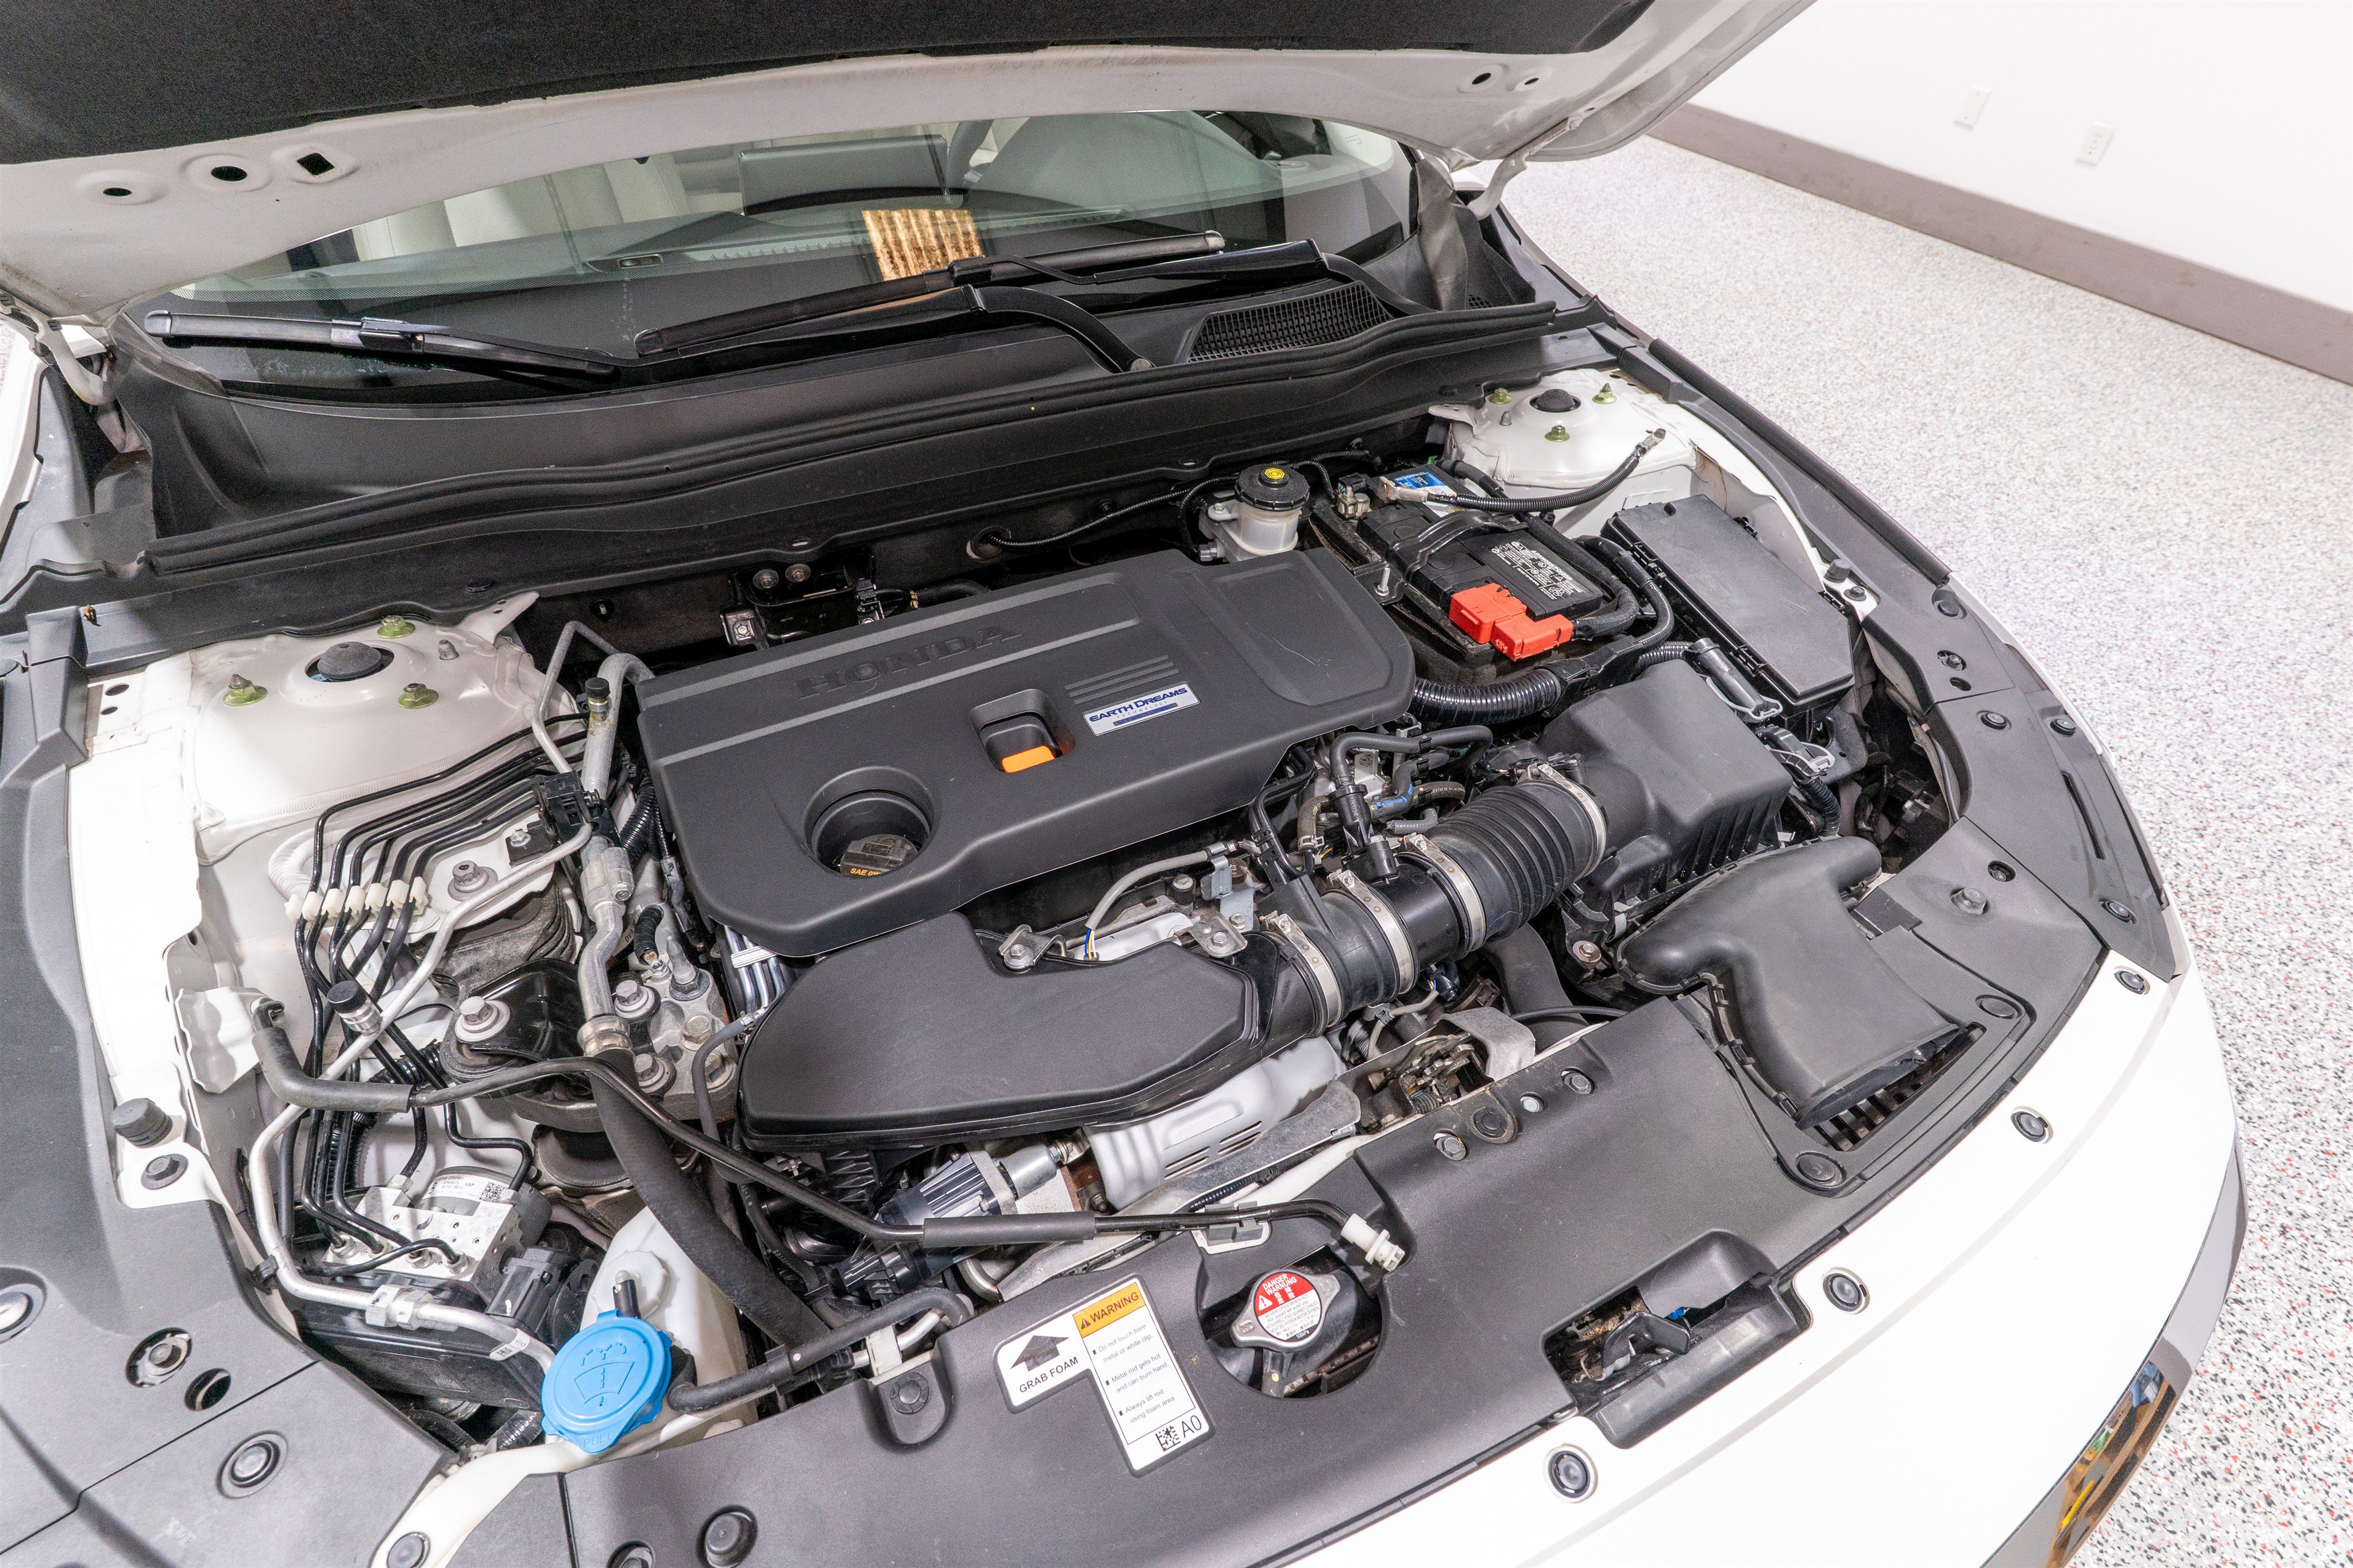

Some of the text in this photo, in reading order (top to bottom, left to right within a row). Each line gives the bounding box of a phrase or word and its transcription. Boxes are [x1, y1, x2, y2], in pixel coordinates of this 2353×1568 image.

[794, 627, 1022, 700] HONDA
[1089, 704, 1133, 722] EARTH
[1133, 688, 1188, 708] DREAMS
[1117, 701, 1168, 719] TECHNOLOGY
[850, 868, 866, 876] SAE
[1263, 1273, 1289, 1291] DANGER
[1266, 1276, 1297, 1296] WARNUNG
[1090, 1292, 1139, 1322] WARNING
[1264, 1310, 1278, 1318] NEVER
[1278, 1303, 1289, 1312] OPEN
[1289, 1298, 1301, 1306] WHEN
[1292, 1308, 1305, 1317] QUAND
[1305, 1301, 1318, 1311] CHAUD
[1297, 1312, 1307, 1320] MOTOR
[1098, 1323, 1146, 1353] Do not touch bare
[1103, 1352, 1119, 1363] metal
[1127, 1340, 1141, 1350] white
[1141, 1333, 1153, 1344] clip.
[1019, 1356, 1078, 1392] GRAB FOAM
[1111, 1353, 1162, 1383] Metal rod gets hot
[1116, 1361, 1169, 1393] and can burn hand.
[1125, 1399, 1146, 1413] Always
[1154, 1388, 1164, 1397] rod
[1130, 1395, 1176, 1423] using foam area.
[1181, 1415, 1202, 1438] A0
[584, 1433, 612, 1447] PULL
